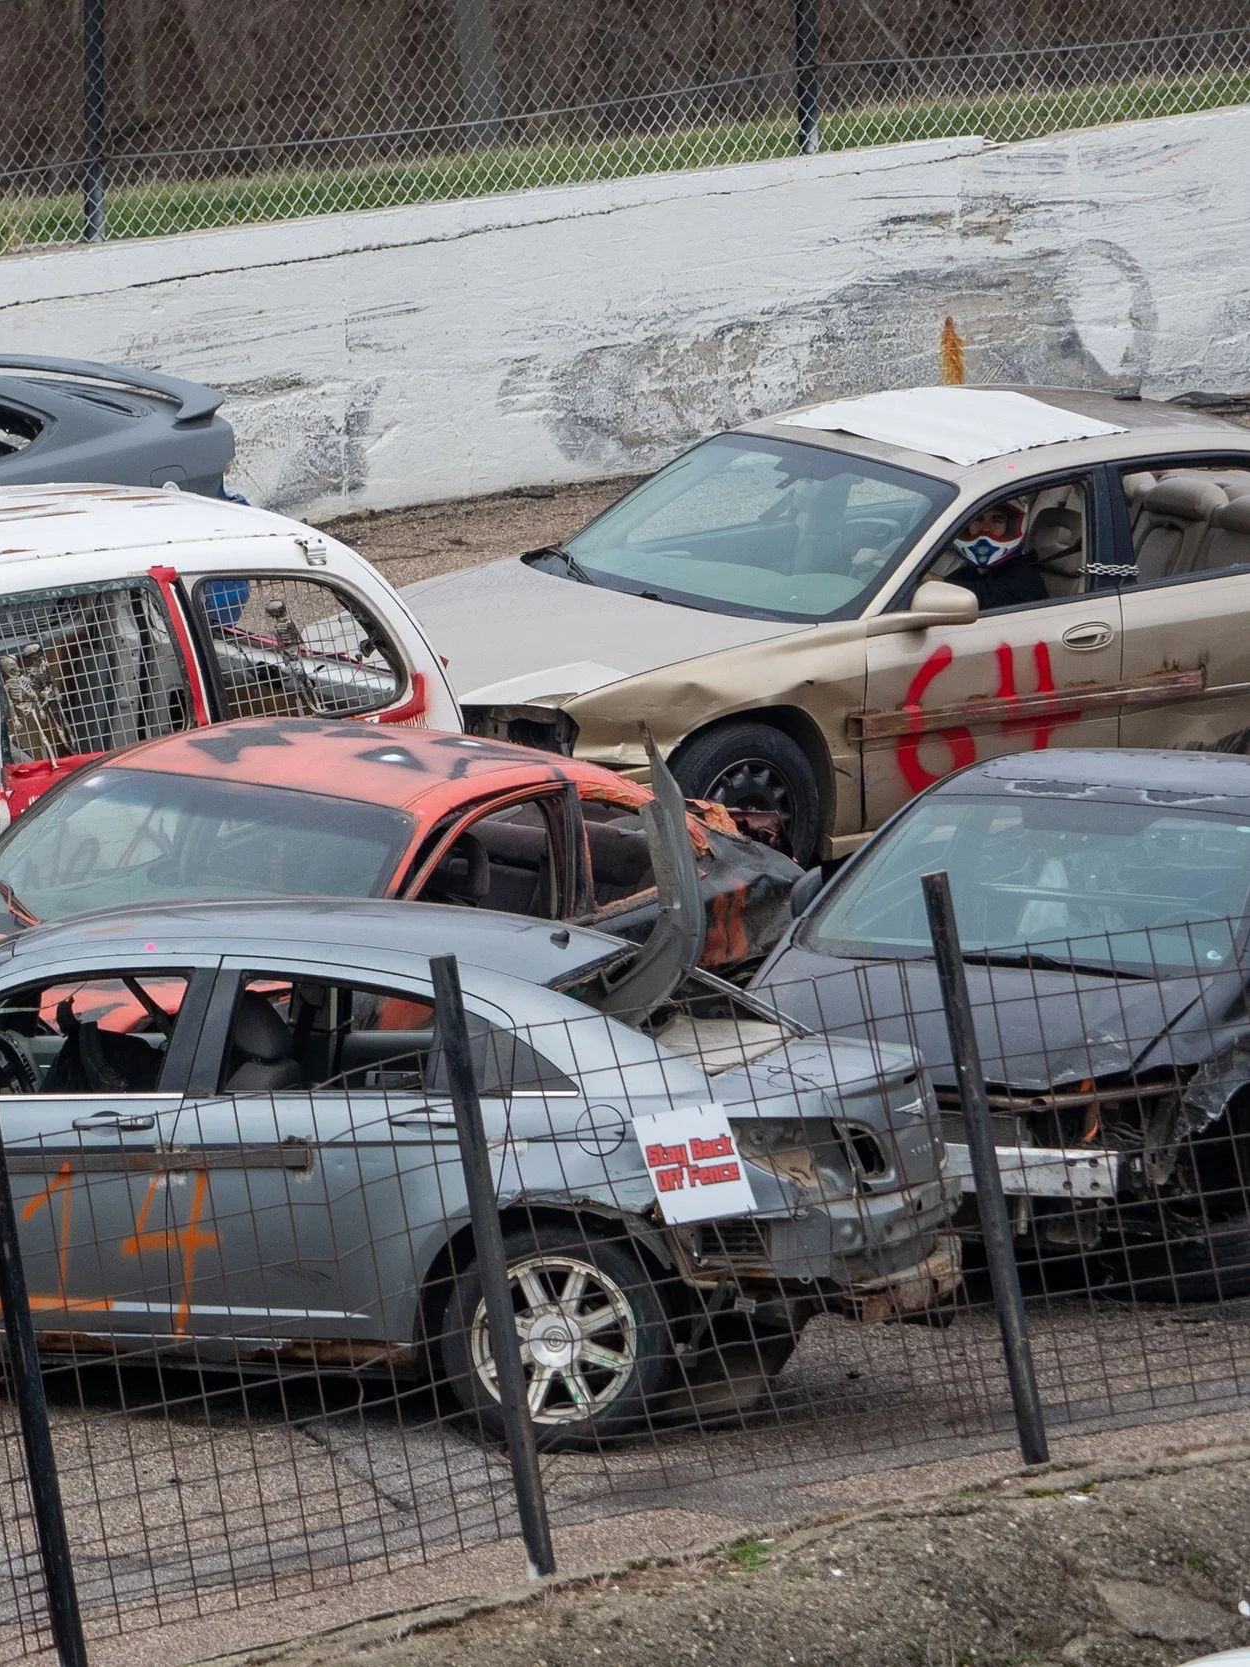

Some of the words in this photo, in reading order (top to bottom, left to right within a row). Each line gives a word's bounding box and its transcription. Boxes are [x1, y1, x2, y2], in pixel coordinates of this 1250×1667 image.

[897, 641, 1081, 796] 64
[645, 1143, 689, 1168] Stay
[689, 1133, 735, 1160] Back
[687, 1162, 741, 1188] Fence
